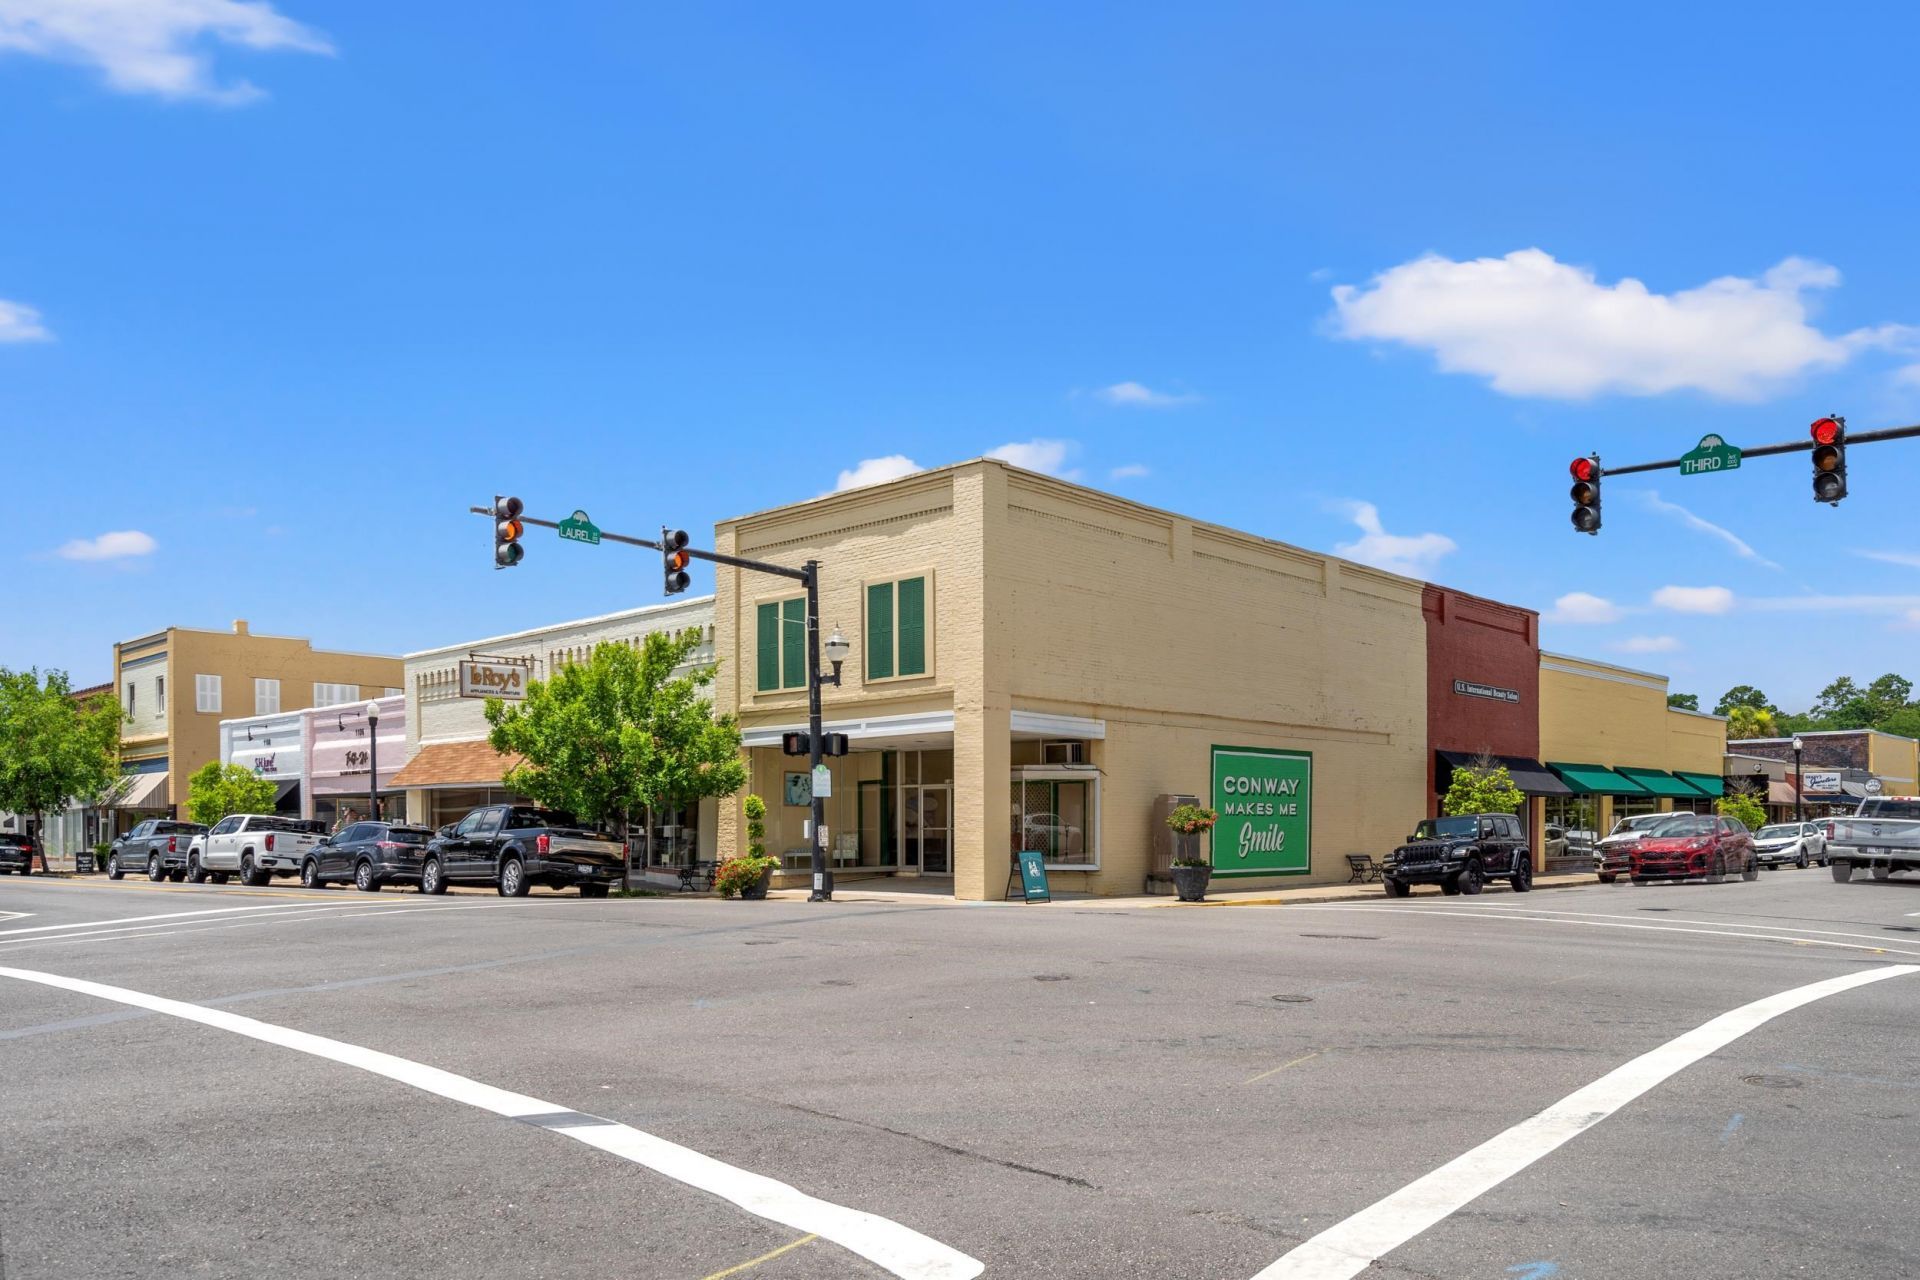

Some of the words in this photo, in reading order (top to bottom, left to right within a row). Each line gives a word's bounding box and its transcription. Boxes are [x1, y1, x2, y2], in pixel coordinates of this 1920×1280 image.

[1684, 456, 1721, 473] THIRD
[560, 526, 592, 542] LAUREL
[1467, 684, 1493, 697] International
[1493, 688, 1507, 701] Beauty
[1506, 691, 1518, 700] Salon
[1223, 776, 1300, 797] CONWAY
[1225, 802, 1274, 816] MAKES
[1279, 803, 1297, 816] ME
[1238, 822, 1285, 858] Smile
